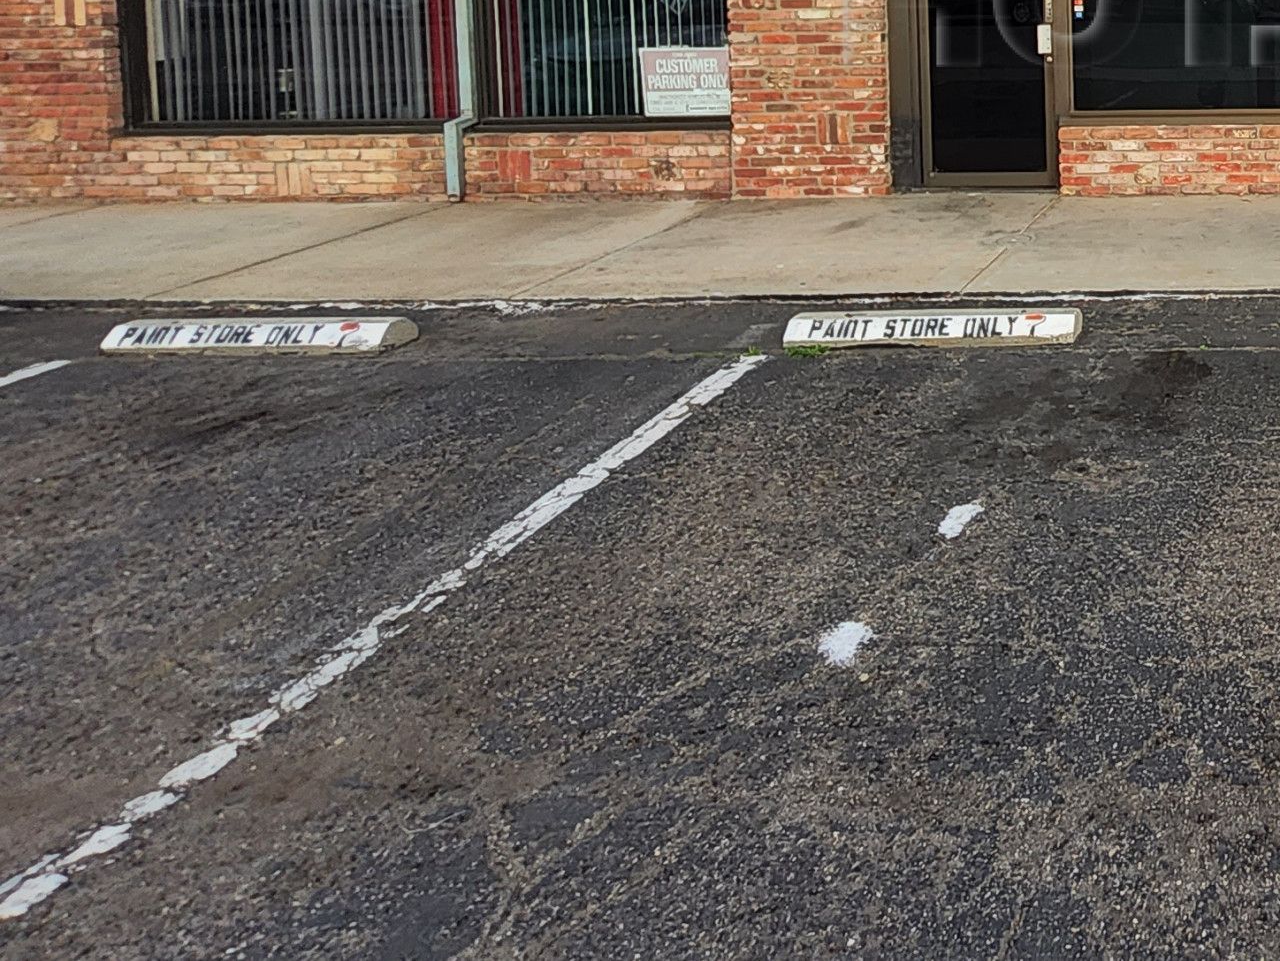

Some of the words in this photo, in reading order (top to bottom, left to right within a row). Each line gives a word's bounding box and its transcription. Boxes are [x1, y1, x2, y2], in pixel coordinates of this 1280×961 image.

[655, 58, 719, 74] CUSTOMER
[647, 73, 697, 90] PARKING
[700, 72, 728, 89] ONLY
[116, 324, 184, 348] PAINT
[188, 324, 262, 346] STORE
[263, 323, 326, 347] ONLY
[807, 319, 873, 339] PAINT
[882, 317, 954, 338] STORE
[961, 316, 1019, 338] ONLY
